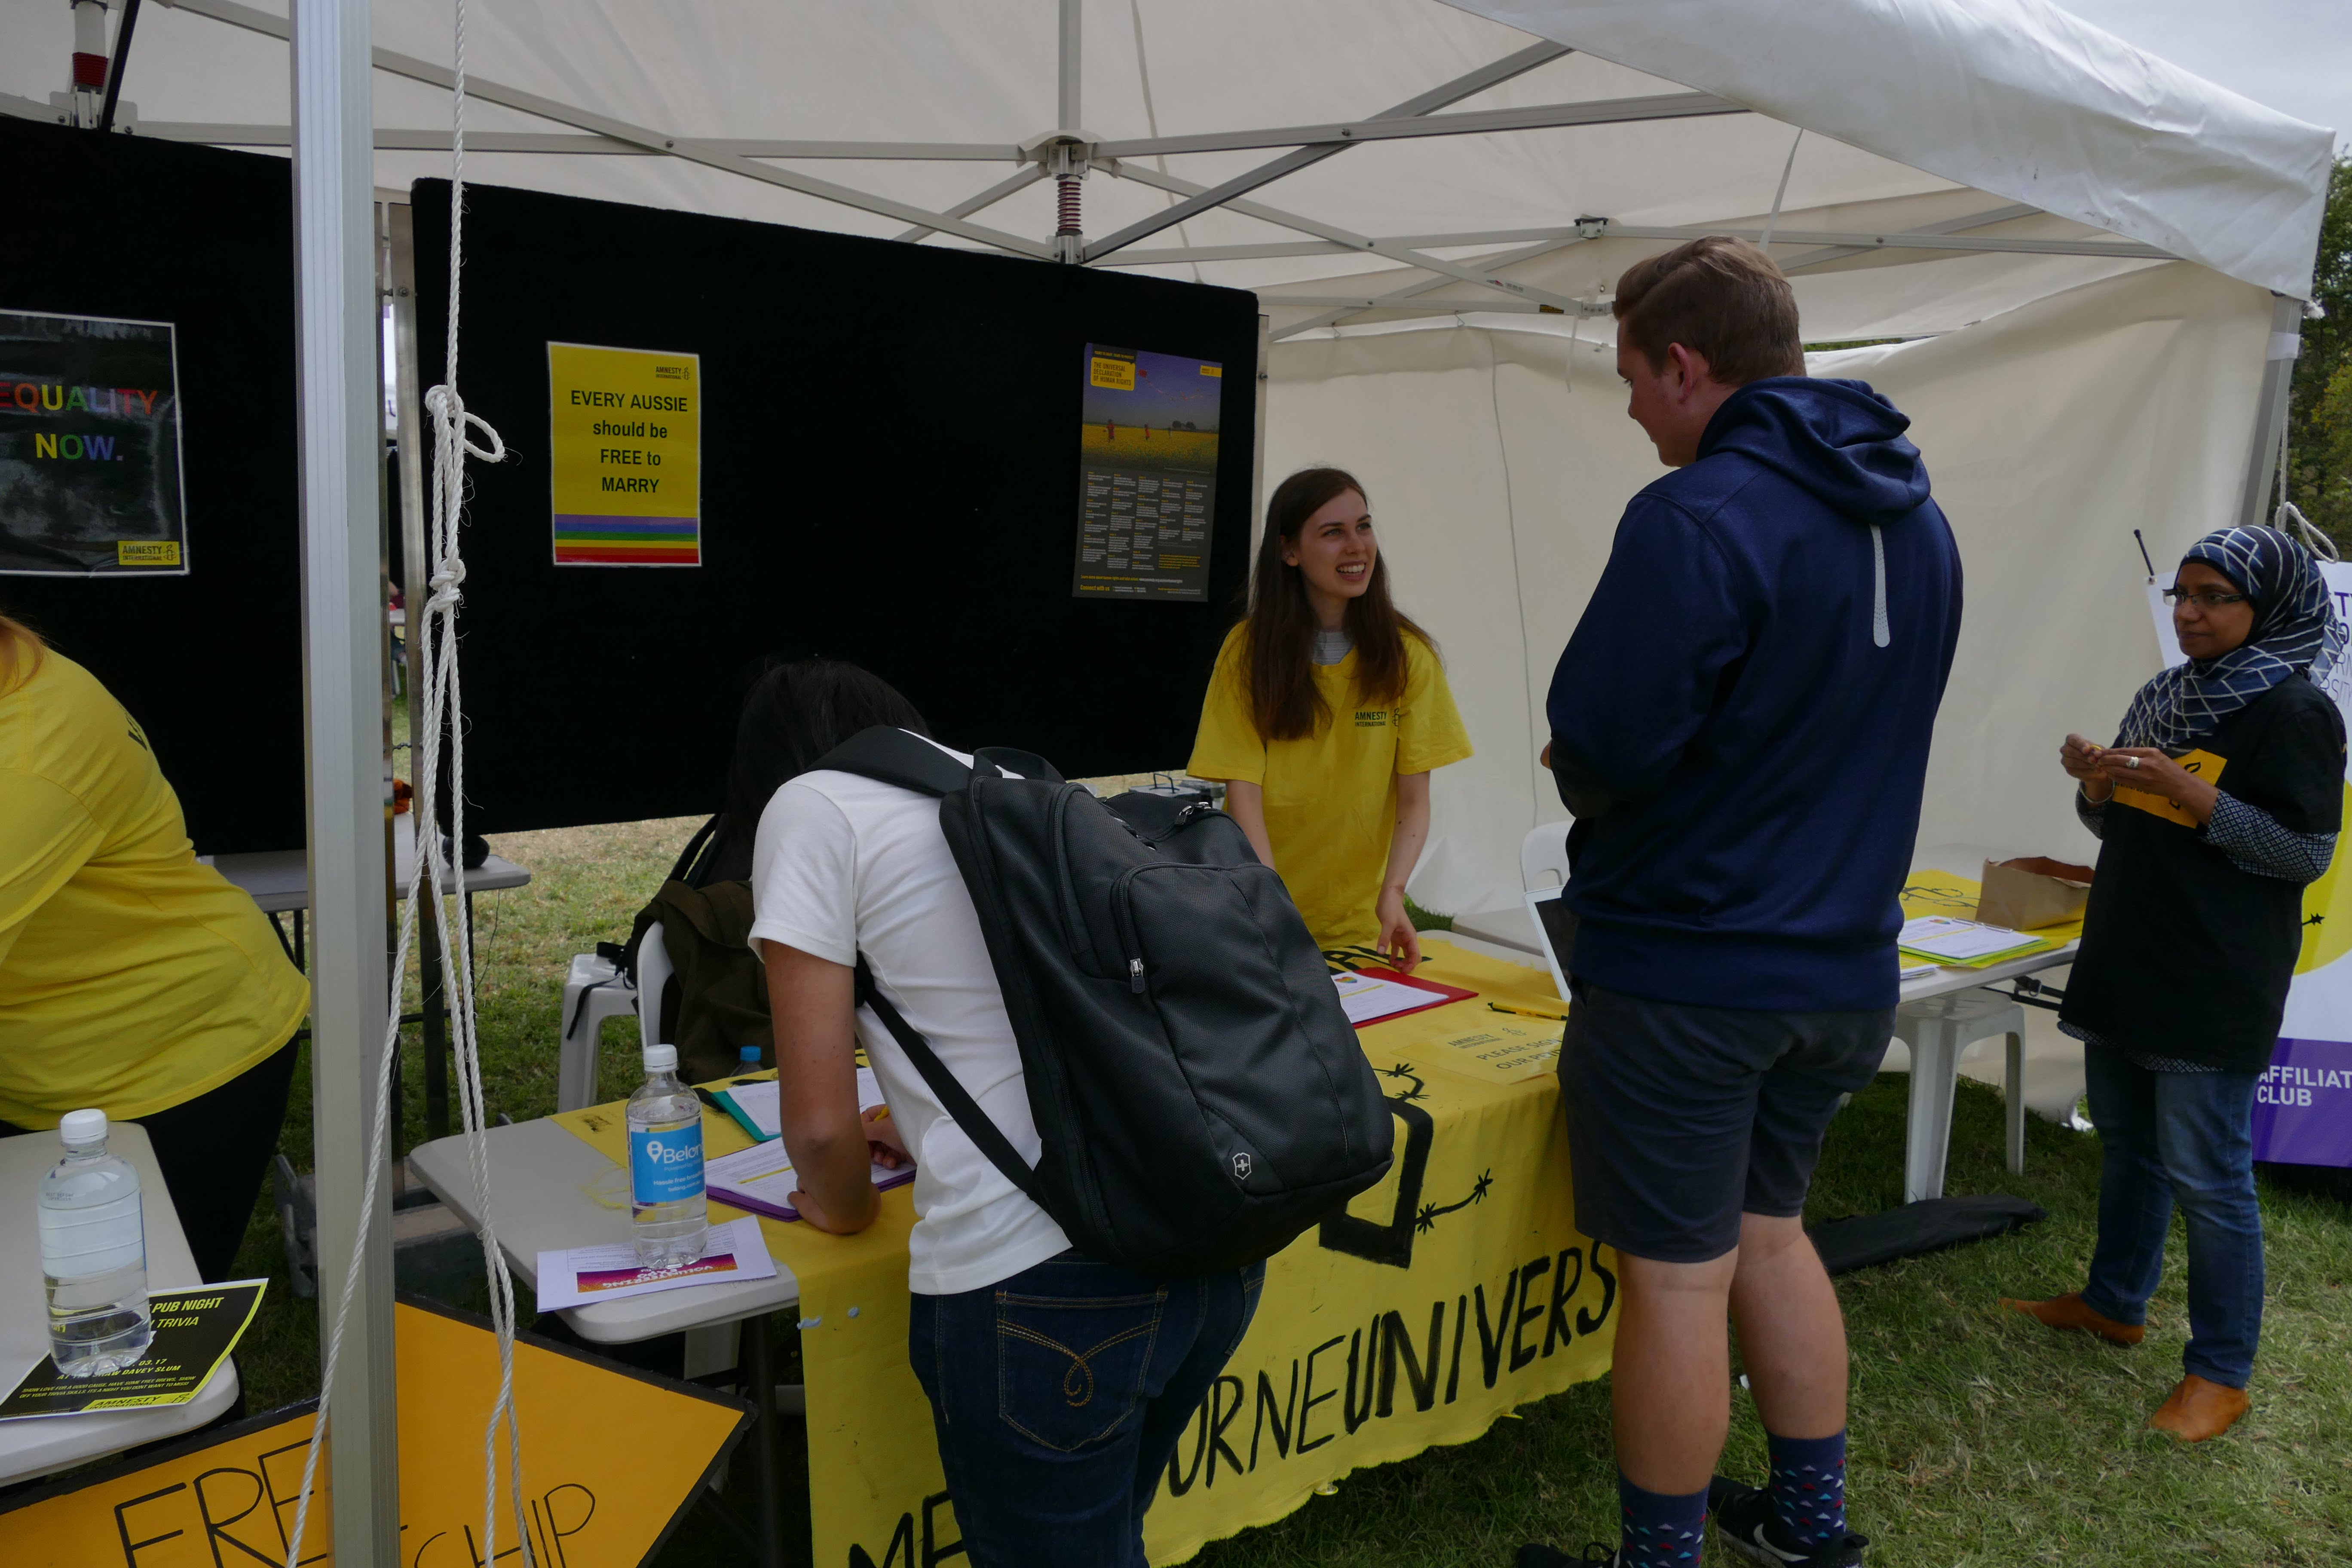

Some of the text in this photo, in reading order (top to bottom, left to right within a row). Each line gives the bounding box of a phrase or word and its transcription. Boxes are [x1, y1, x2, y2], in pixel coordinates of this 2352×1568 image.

[1093, 369, 1121, 378] DECLARATION
[1103, 363, 1125, 372] UNIVERSAL
[1116, 378, 1131, 386] RIGHTS
[0, 383, 157, 415] EQUALITY
[571, 390, 688, 412] EVERY AUSSIE
[593, 420, 668, 439] should be
[36, 433, 123, 461] NOW.
[600, 449, 661, 466] FREE to
[601, 477, 660, 493] MARRY
[122, 545, 162, 554] AMNESTY
[1355, 711, 1387, 720] AMNESTY
[1448, 1034, 1494, 1046] AMNESTY
[1476, 1038, 1563, 1060] PLEASE SIGN
[1496, 1058, 1533, 1069] OUR
[2257, 1085, 2312, 1107] CLUB
[602, 1265, 714, 1288] VOLUNTEERING
[637, 1268, 677, 1278] EXPO
[151, 1301, 181, 1314] PUB
[181, 1297, 225, 1311] NIGHT
[156, 1317, 199, 1328] TRIVIA
[122, 1367, 154, 1375] DAVEY
[94, 1396, 162, 1406] AMNESTY
